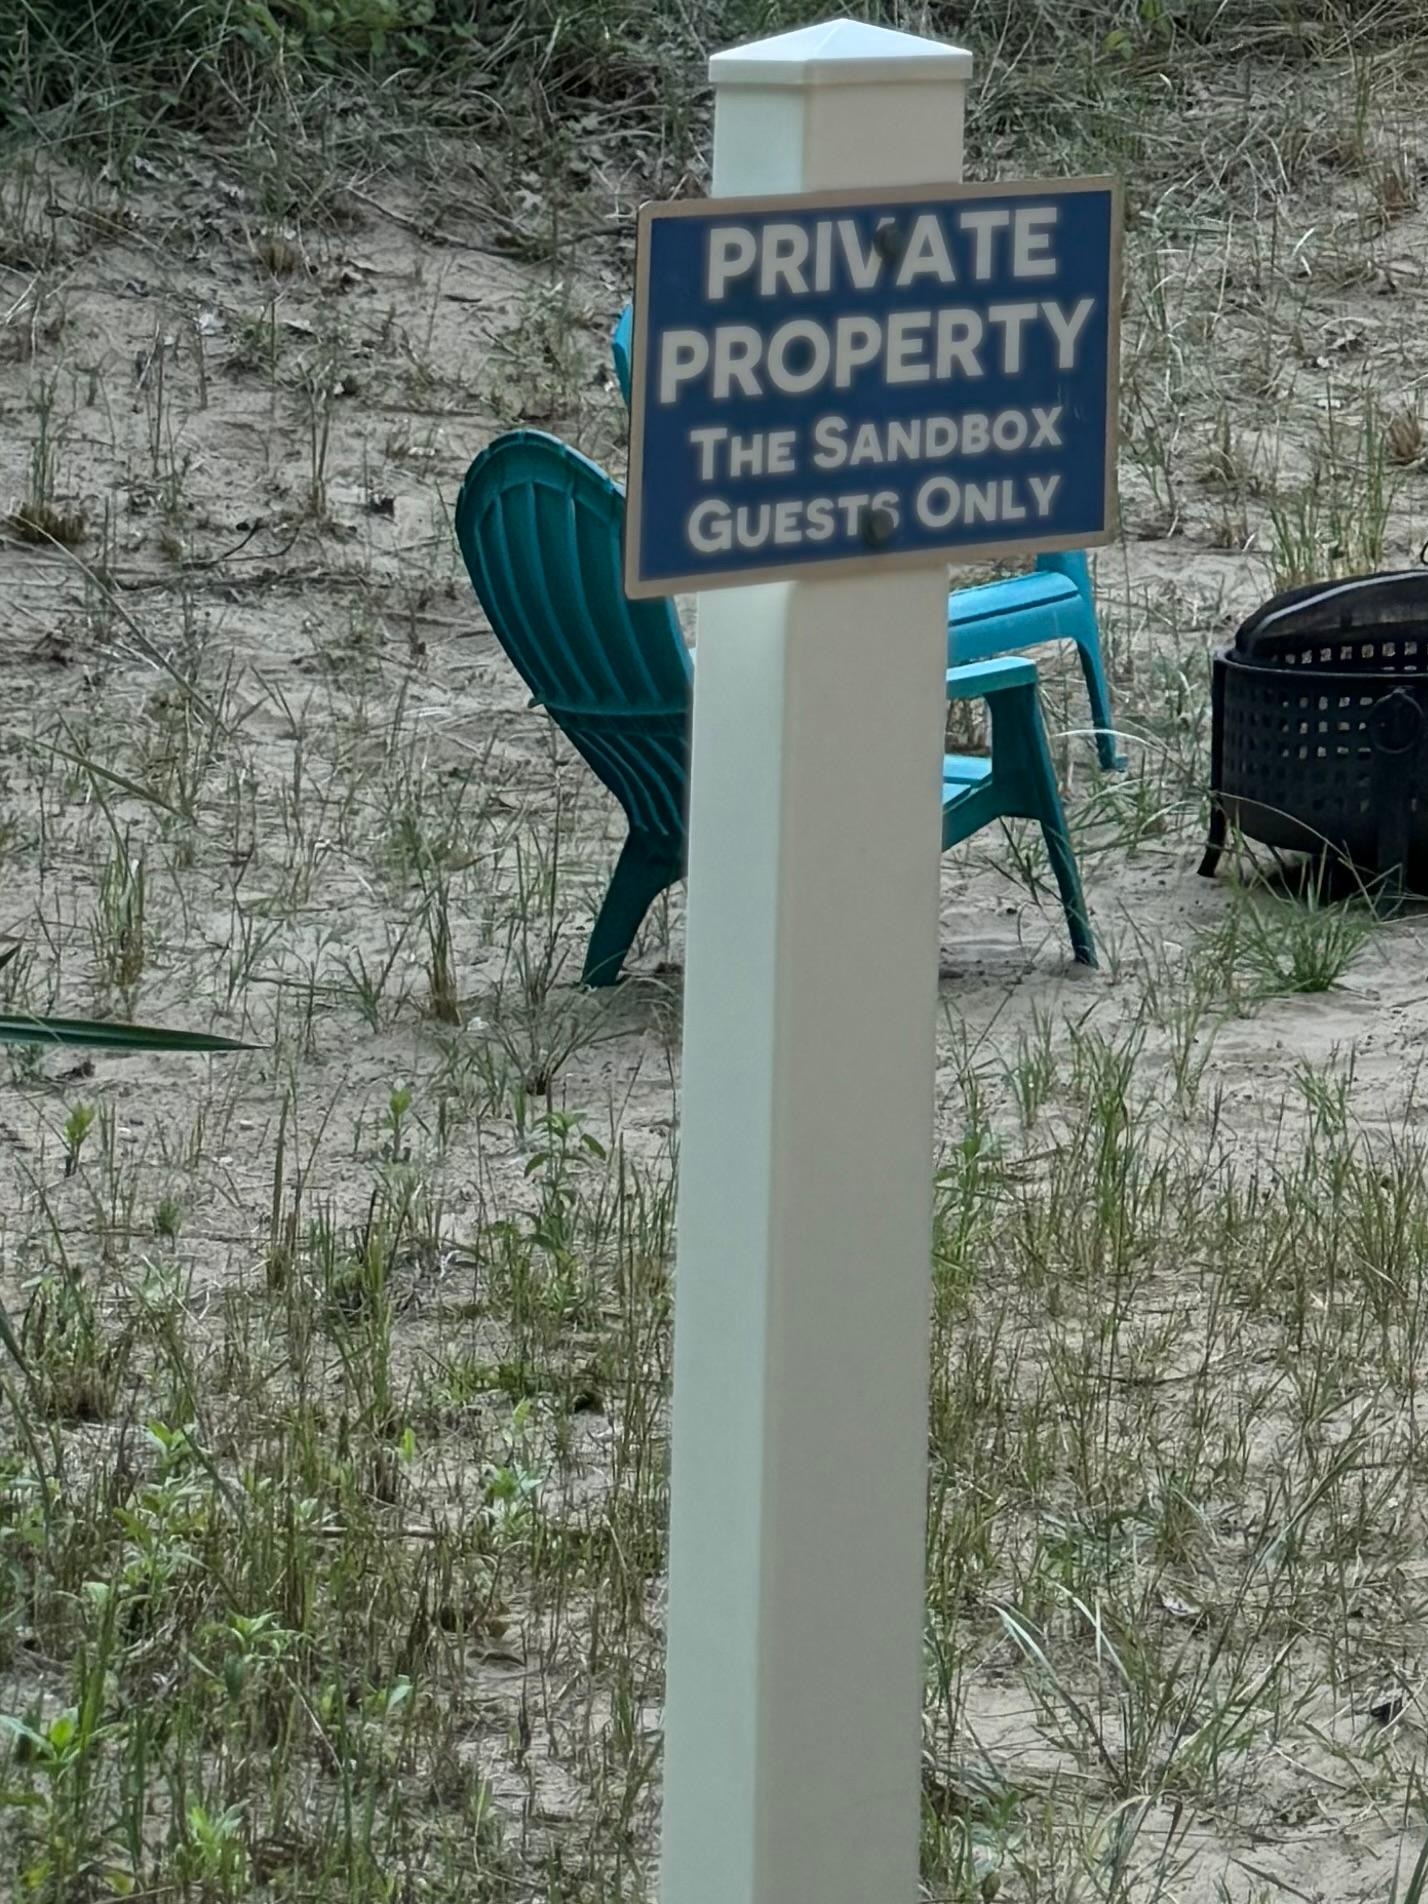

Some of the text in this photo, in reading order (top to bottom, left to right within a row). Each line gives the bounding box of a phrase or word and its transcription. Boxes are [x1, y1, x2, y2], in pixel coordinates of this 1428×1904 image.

[708, 207, 1058, 299] PRIVATE
[659, 299, 1096, 404] PROPERTY
[690, 406, 1063, 480] THE SANDBOX
[687, 475, 1061, 553] GUESTS ONLY
